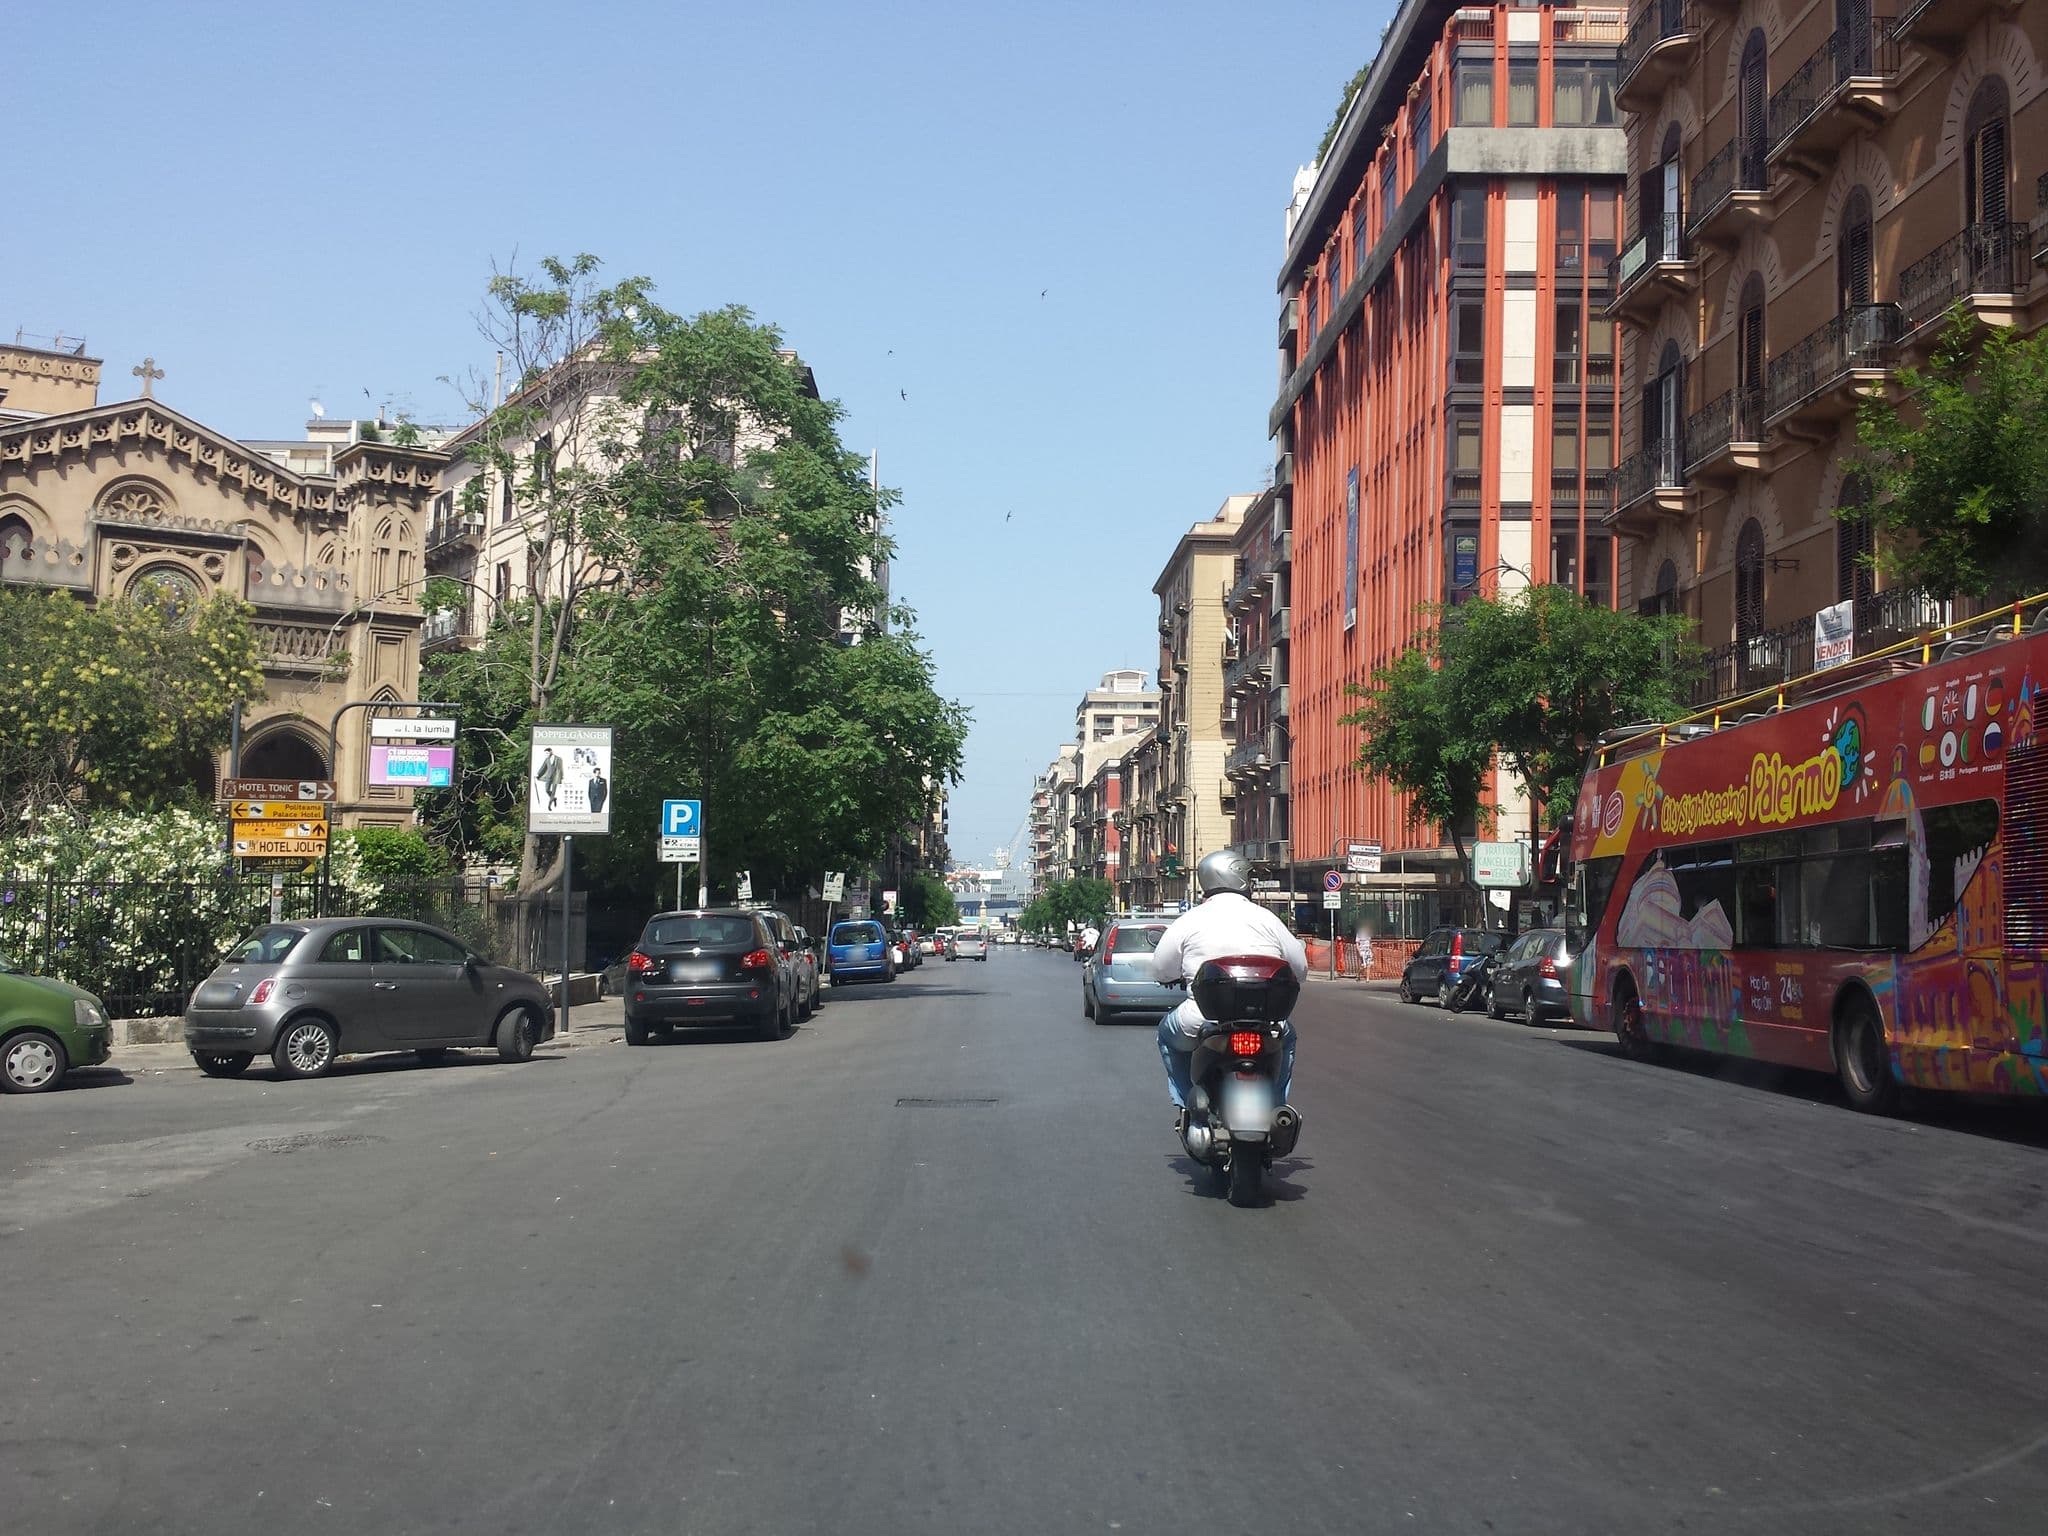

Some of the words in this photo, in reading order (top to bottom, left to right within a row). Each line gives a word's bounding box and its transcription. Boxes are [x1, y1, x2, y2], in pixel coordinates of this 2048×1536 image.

[425, 724, 450, 734] lumia
[238, 783, 266, 792] HOTEL
[268, 784, 294, 792] TONIC
[1750, 746, 1841, 823] Palermo
[670, 804, 693, 832] P
[259, 841, 292, 852] HOTEL
[294, 841, 316, 852] JOLI
